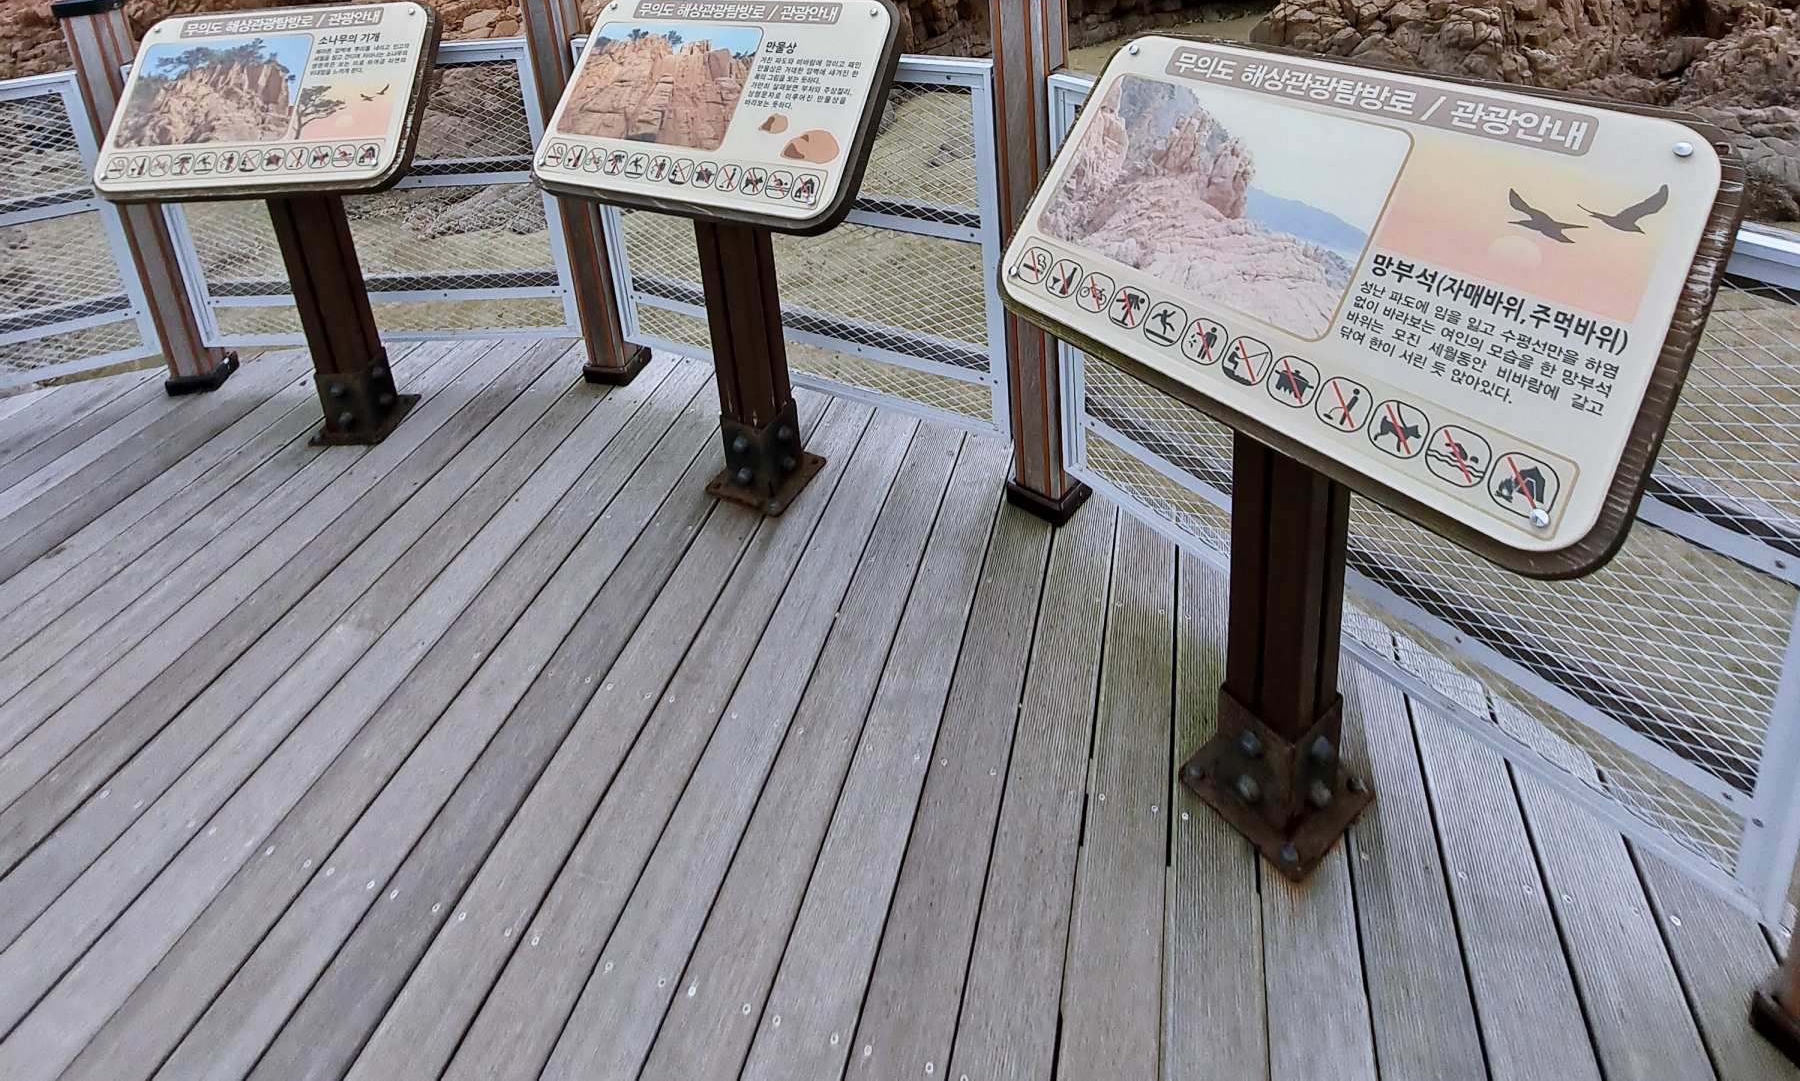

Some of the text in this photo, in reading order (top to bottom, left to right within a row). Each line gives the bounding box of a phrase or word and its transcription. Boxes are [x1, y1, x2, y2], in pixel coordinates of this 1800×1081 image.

[185, 21, 222, 36] 무의도
[327, 10, 381, 26] 관광안내
[638, 2, 675, 17] 무의도
[677, 2, 766, 19] 해상관광탐방로
[780, 5, 839, 22] 관광안내
[318, 34, 358, 45] 소나무의
[765, 41, 797, 54] 만물상
[1174, 52, 1589, 151] 무의도 해상관광탐방로 / 관광안내
[1353, 295, 1613, 399] 없이 바라보는 여인의 모습을 한 망부석
[1360, 280, 1386, 299] 성난
[1388, 290, 1431, 314] 파도에
[1500, 329, 1579, 366] 수평선만을
[1584, 357, 1620, 380] 하염
[1346, 310, 1384, 334] 바위는
[1391, 328, 1421, 348] 모진
[1428, 342, 1488, 374] 세월동안
[1496, 366, 1560, 401] 비바람에
[1368, 336, 1396, 358] 한이
[1399, 349, 1428, 370] 서린
[1430, 360, 1447, 377] 듯
